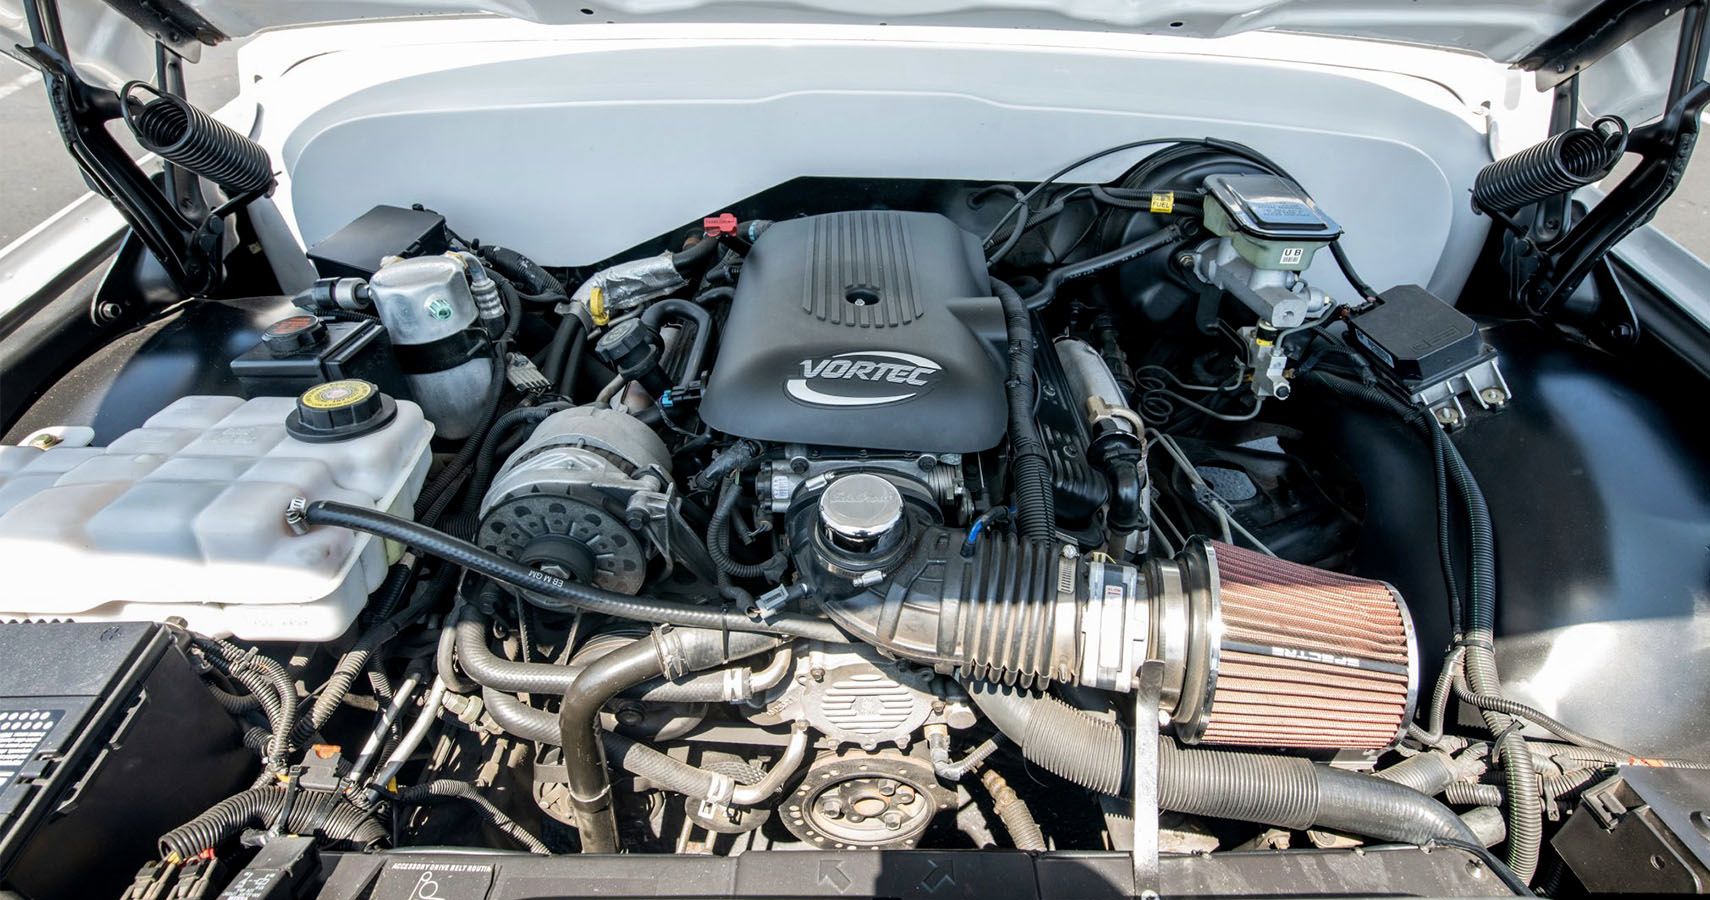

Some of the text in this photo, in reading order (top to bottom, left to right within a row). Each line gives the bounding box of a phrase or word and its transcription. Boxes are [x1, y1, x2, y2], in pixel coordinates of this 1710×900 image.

[800, 359, 937, 386] VORTEC
[528, 570, 564, 588] EB M GM
[1272, 646, 1360, 667] SPECTRE
[392, 863, 430, 871] ACCESSORY
[430, 863, 449, 871] DRIVE
[449, 864, 468, 872] BELT
